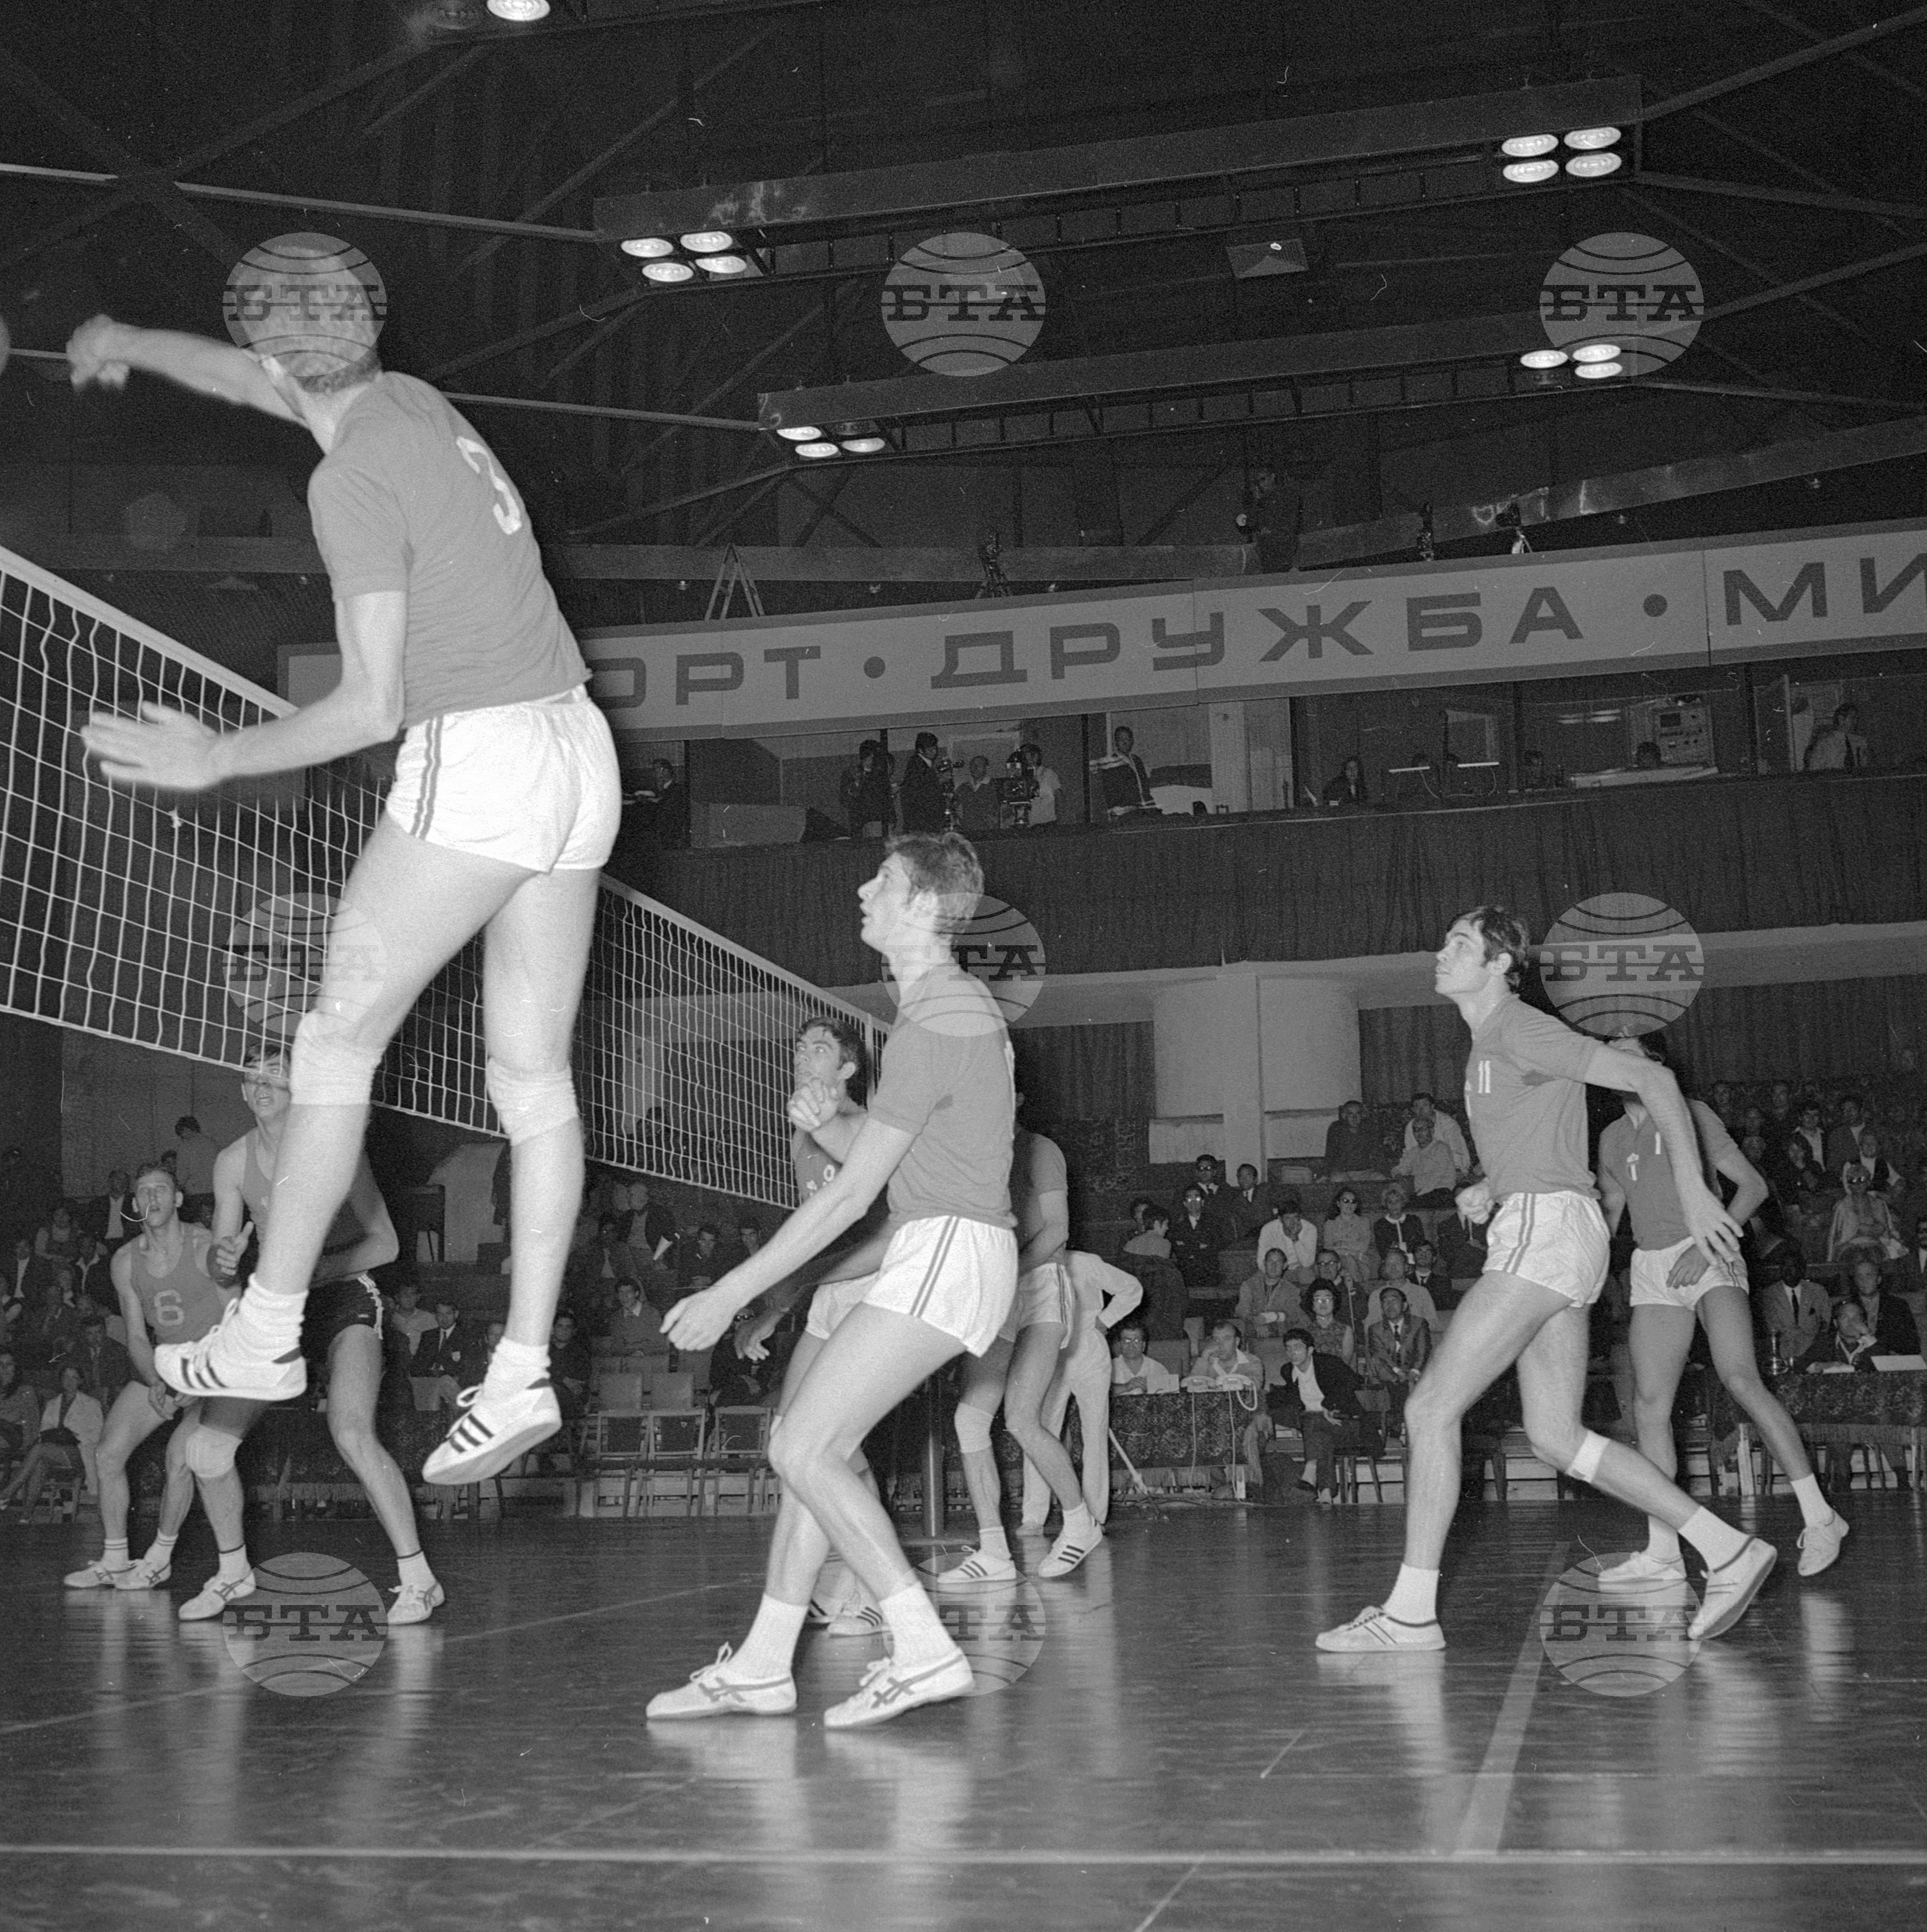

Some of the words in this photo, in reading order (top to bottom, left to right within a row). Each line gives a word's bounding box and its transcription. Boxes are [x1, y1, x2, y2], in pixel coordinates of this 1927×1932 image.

[456, 436, 522, 535] 3
[586, 645, 821, 709] ОРТ
[931, 586, 1584, 690] ДРУЖБА
[1478, 1060, 1491, 1094] 11
[154, 1289, 185, 1326] 6
